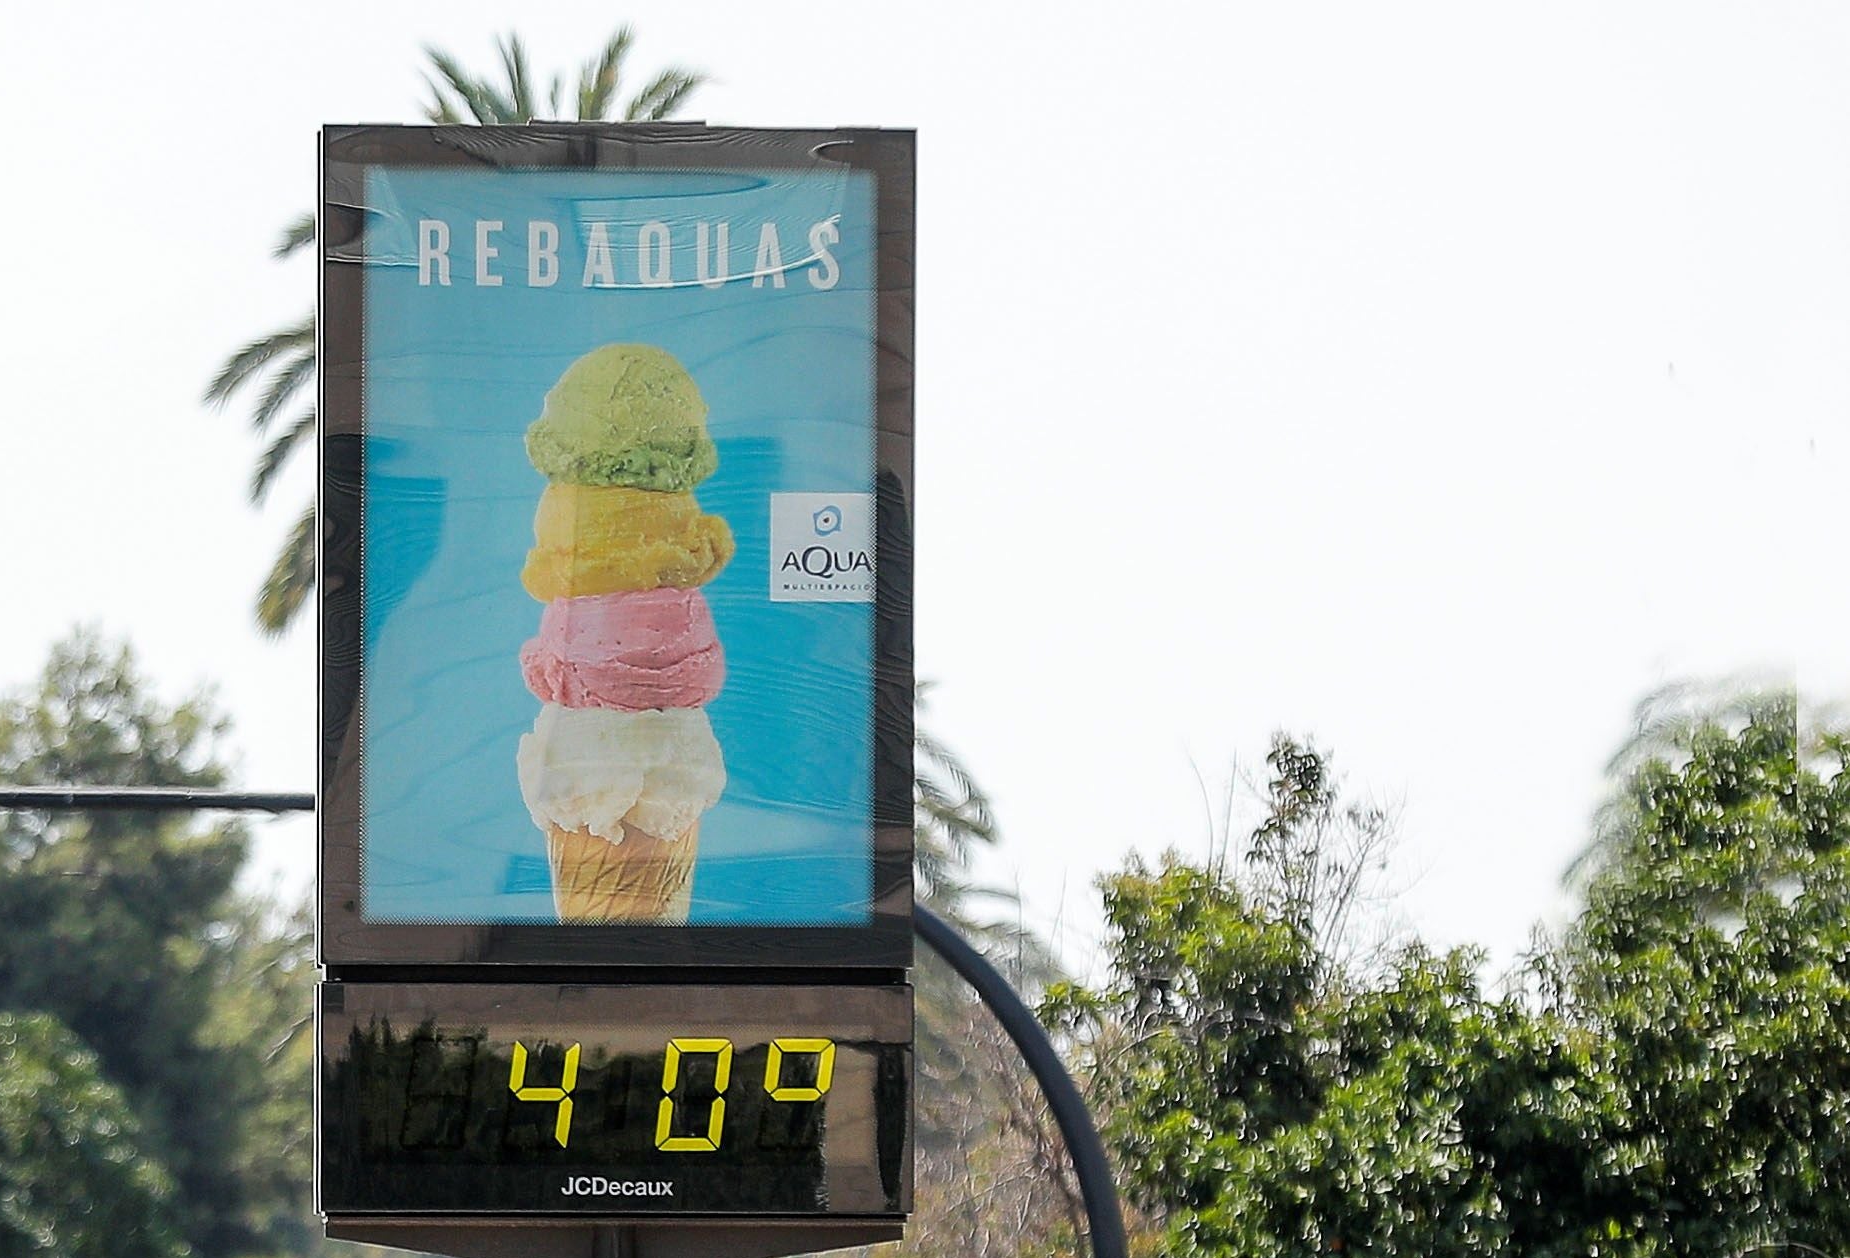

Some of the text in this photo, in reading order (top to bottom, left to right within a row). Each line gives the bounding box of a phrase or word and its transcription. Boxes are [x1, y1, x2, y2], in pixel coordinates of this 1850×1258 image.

[418, 219, 840, 289] REBAQUAS
[781, 545, 871, 579] AQUA
[783, 583, 871, 591] MULTIESPACIO
[561, 1176, 674, 1197] JCDecaux
